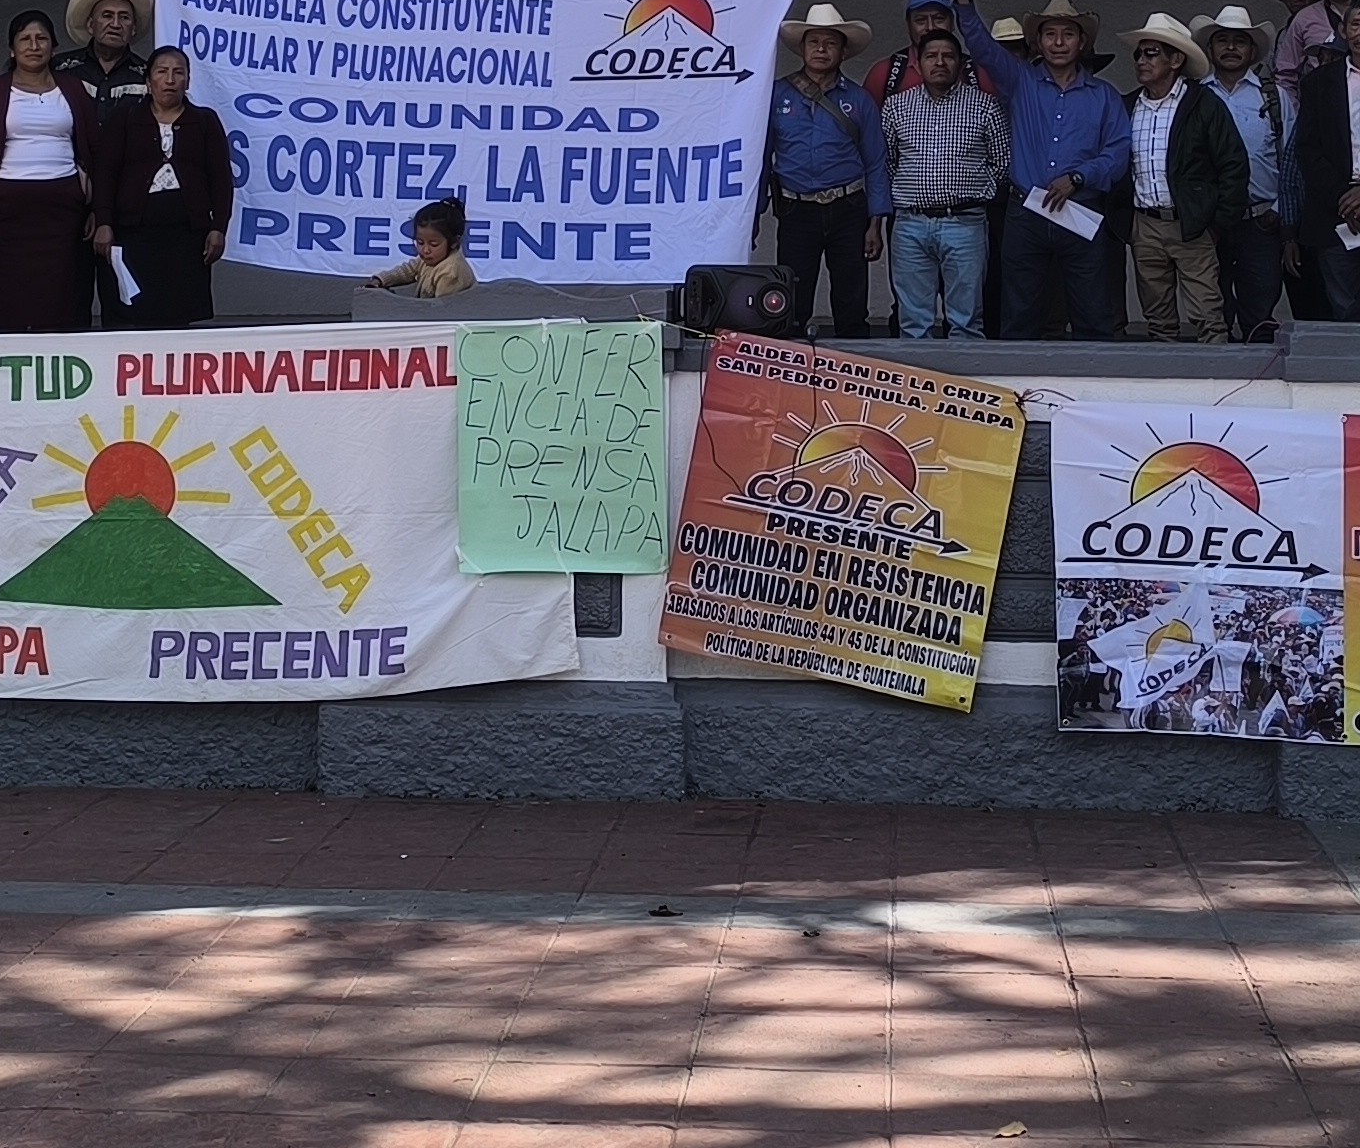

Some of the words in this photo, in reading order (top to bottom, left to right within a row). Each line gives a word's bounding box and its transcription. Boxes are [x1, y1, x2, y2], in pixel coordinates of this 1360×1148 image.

[178, 20, 297, 74] POPULAR
[307, 39, 324, 76] Y
[331, 41, 553, 88] PLURINACIONAL
[585, 45, 737, 77] CODECA
[234, 93, 660, 133] COMUNIDAD
[486, 145, 559, 203] LA
[560, 138, 744, 205] FUENTE
[117, 346, 457, 396] PLURINACIONAL
[717, 356, 761, 376] SAN
[768, 366, 838, 391] PEDRO
[844, 380, 928, 412] PINULA,
[933, 400, 1015, 430] JALAPA
[738, 342, 806, 366] ALDEA
[814, 356, 870, 378] PLAN
[876, 370, 903, 386] DE
[910, 376, 936, 393] LA
[942, 382, 1002, 408] CRUZ
[471, 436, 659, 502] PRENSA
[229, 425, 372, 616] CODECA
[512, 494, 663, 554] JALAPA
[744, 473, 942, 539] CODECA
[767, 512, 912, 560] PRESENTE
[680, 523, 807, 574] COMUNIDAD
[813, 550, 841, 582] EN
[846, 556, 985, 617] RESISTENCIA
[1082, 520, 1300, 565] CODECA
[691, 561, 819, 611] COMUNIDAD
[824, 587, 962, 646] ORGANIZADA
[149, 627, 409, 681] PRECENTE
[705, 630, 752, 659] POLÍTICA
[755, 642, 769, 662] DE
[771, 645, 784, 665] LA
[787, 647, 844, 677] REPÚBLICA
[845, 660, 861, 681] DE
[862, 665, 926, 696] GUATEMALA
[728, 606, 736, 625] A
[738, 608, 758, 629] LOS
[760, 610, 818, 640] ARTÍCULOS
[820, 624, 836, 643] 44
[838, 628, 846, 645] Y
[847, 630, 862, 650] 45
[864, 634, 879, 654] DE
[881, 637, 895, 659] LA
[897, 641, 977, 677] CONSTITUCIÓN
